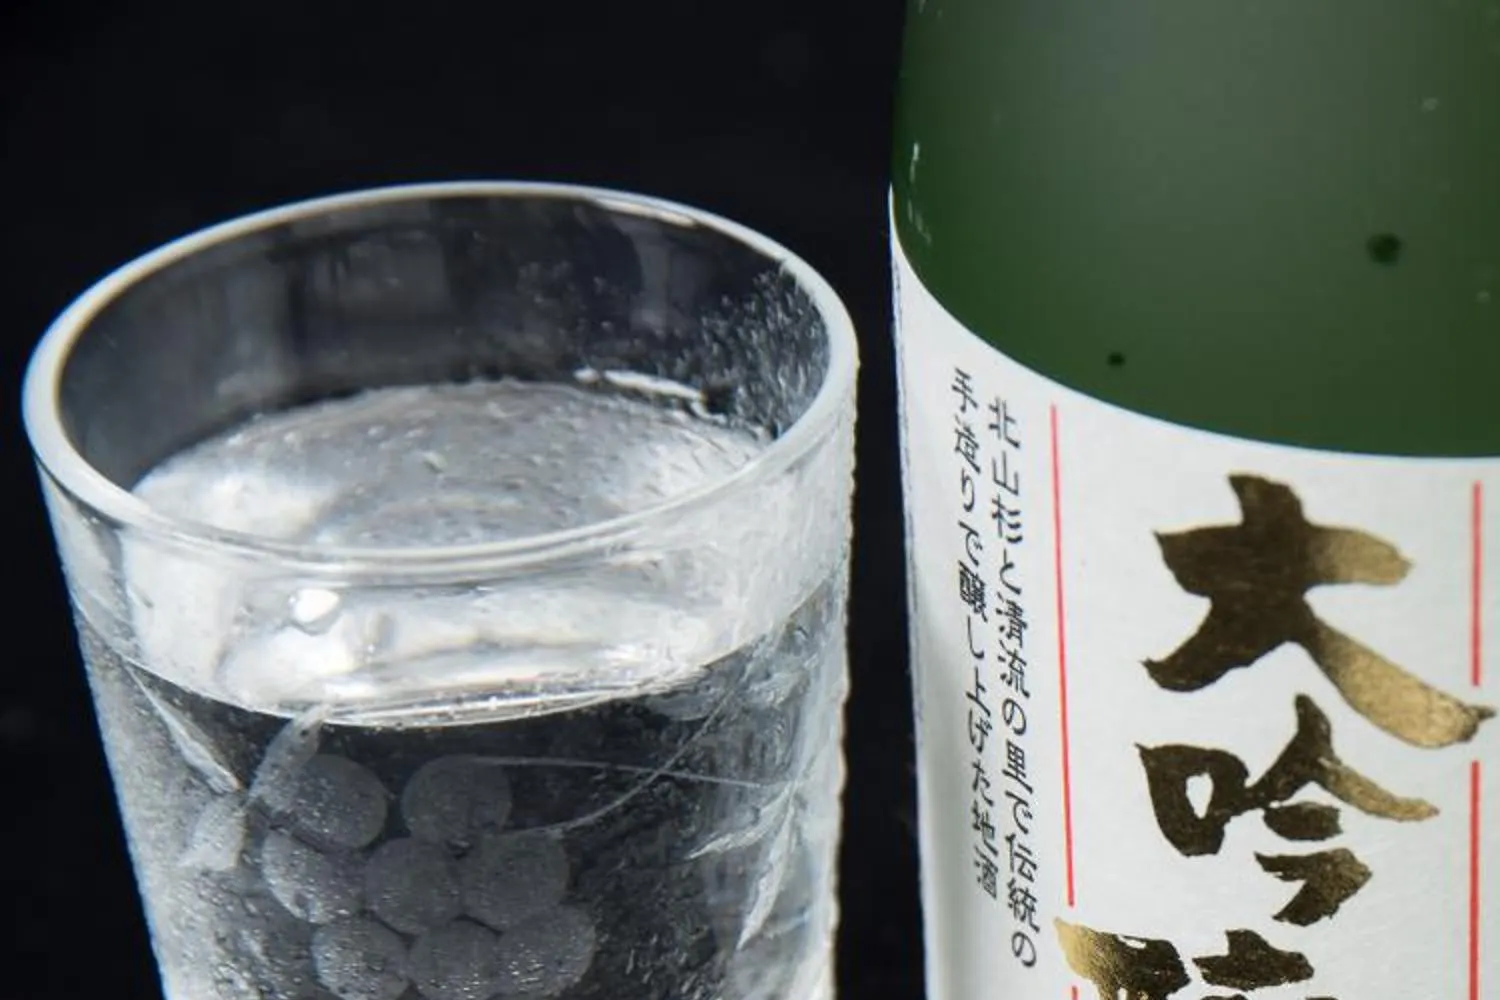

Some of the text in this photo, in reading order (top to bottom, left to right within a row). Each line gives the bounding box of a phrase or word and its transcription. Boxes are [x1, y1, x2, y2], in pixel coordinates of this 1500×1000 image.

[951, 366, 999, 900] 手造りで醸し上げた地酒
[988, 396, 1041, 968] 北山杉と清流の里で伝統の
